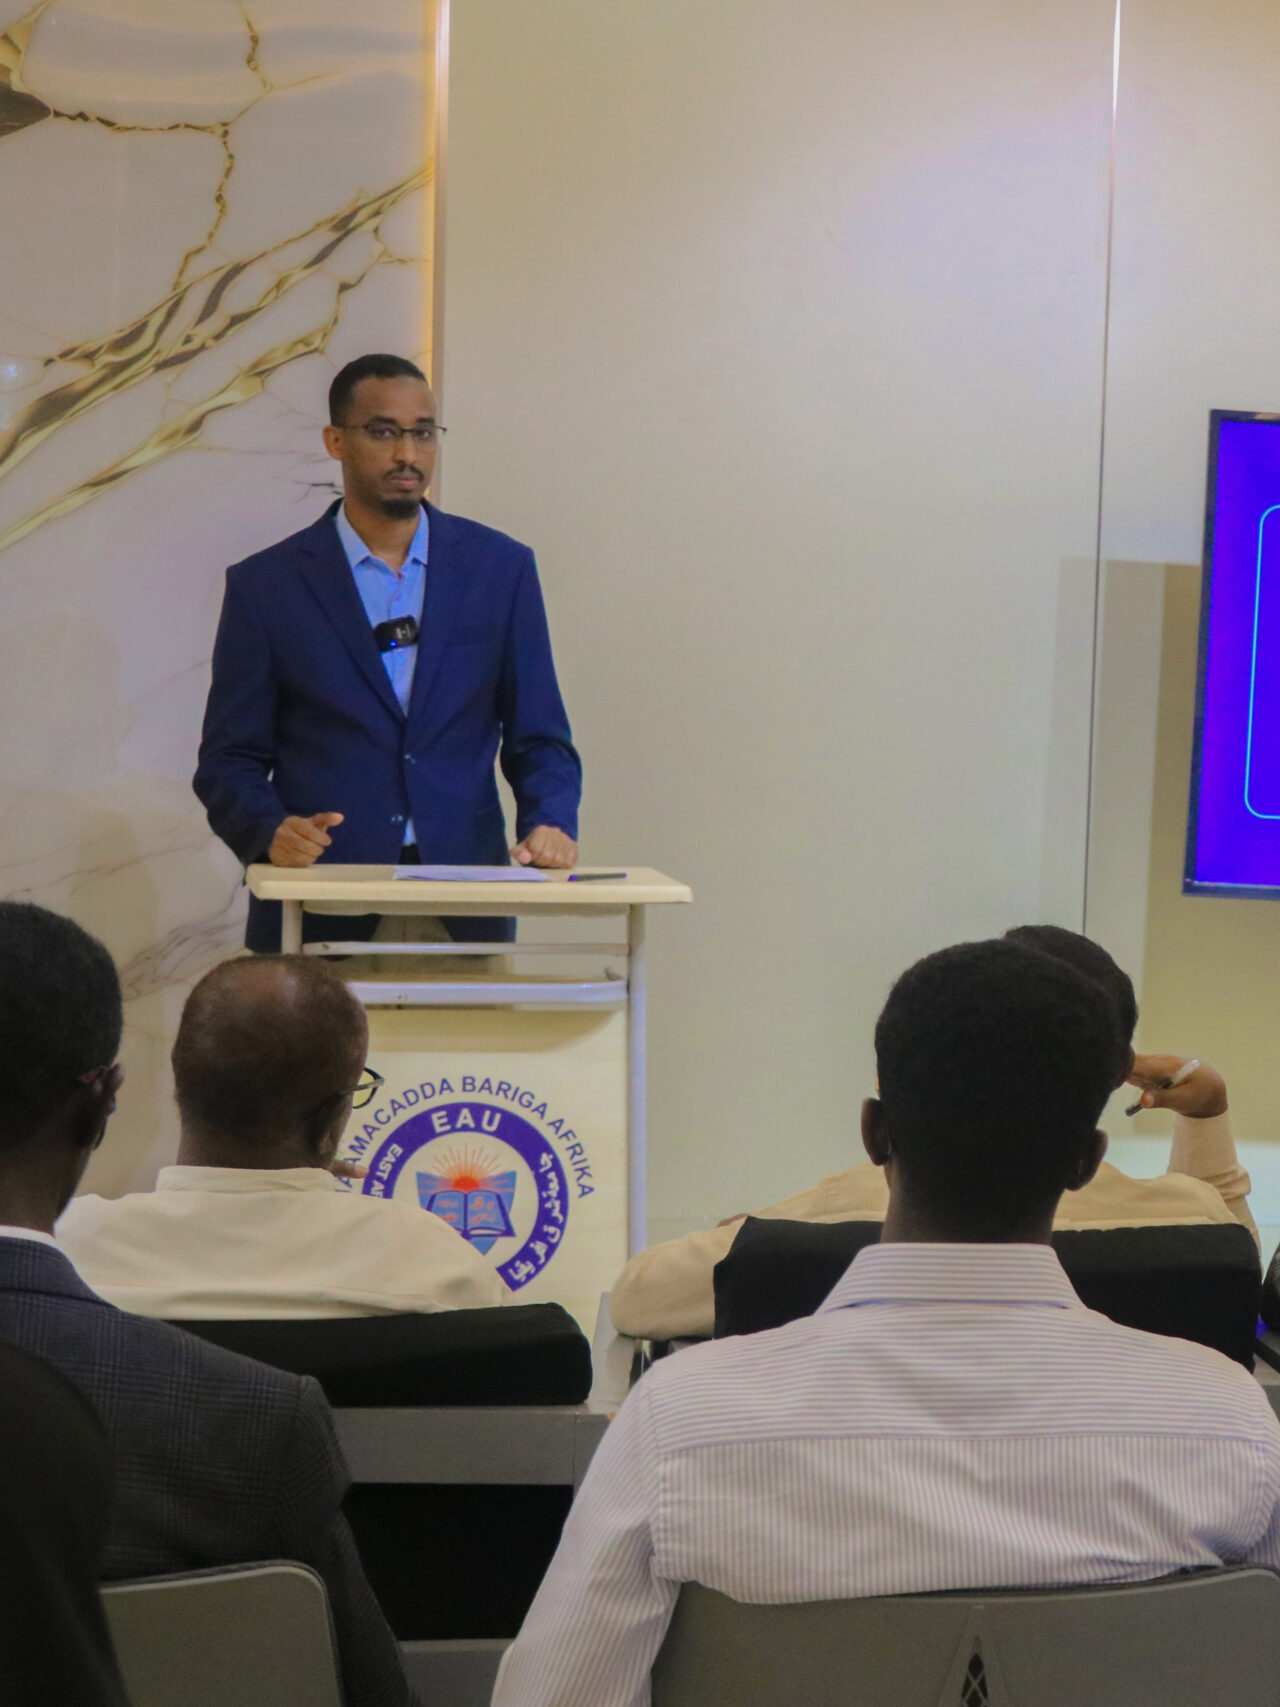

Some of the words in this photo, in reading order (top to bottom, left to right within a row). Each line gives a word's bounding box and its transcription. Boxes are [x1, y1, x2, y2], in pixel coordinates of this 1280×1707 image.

[431, 1108, 501, 1133] EAU
[462, 1076, 548, 1119] BARIGA
[548, 1118, 594, 1199] AFRIKA
[375, 1144, 403, 1181] EAST
